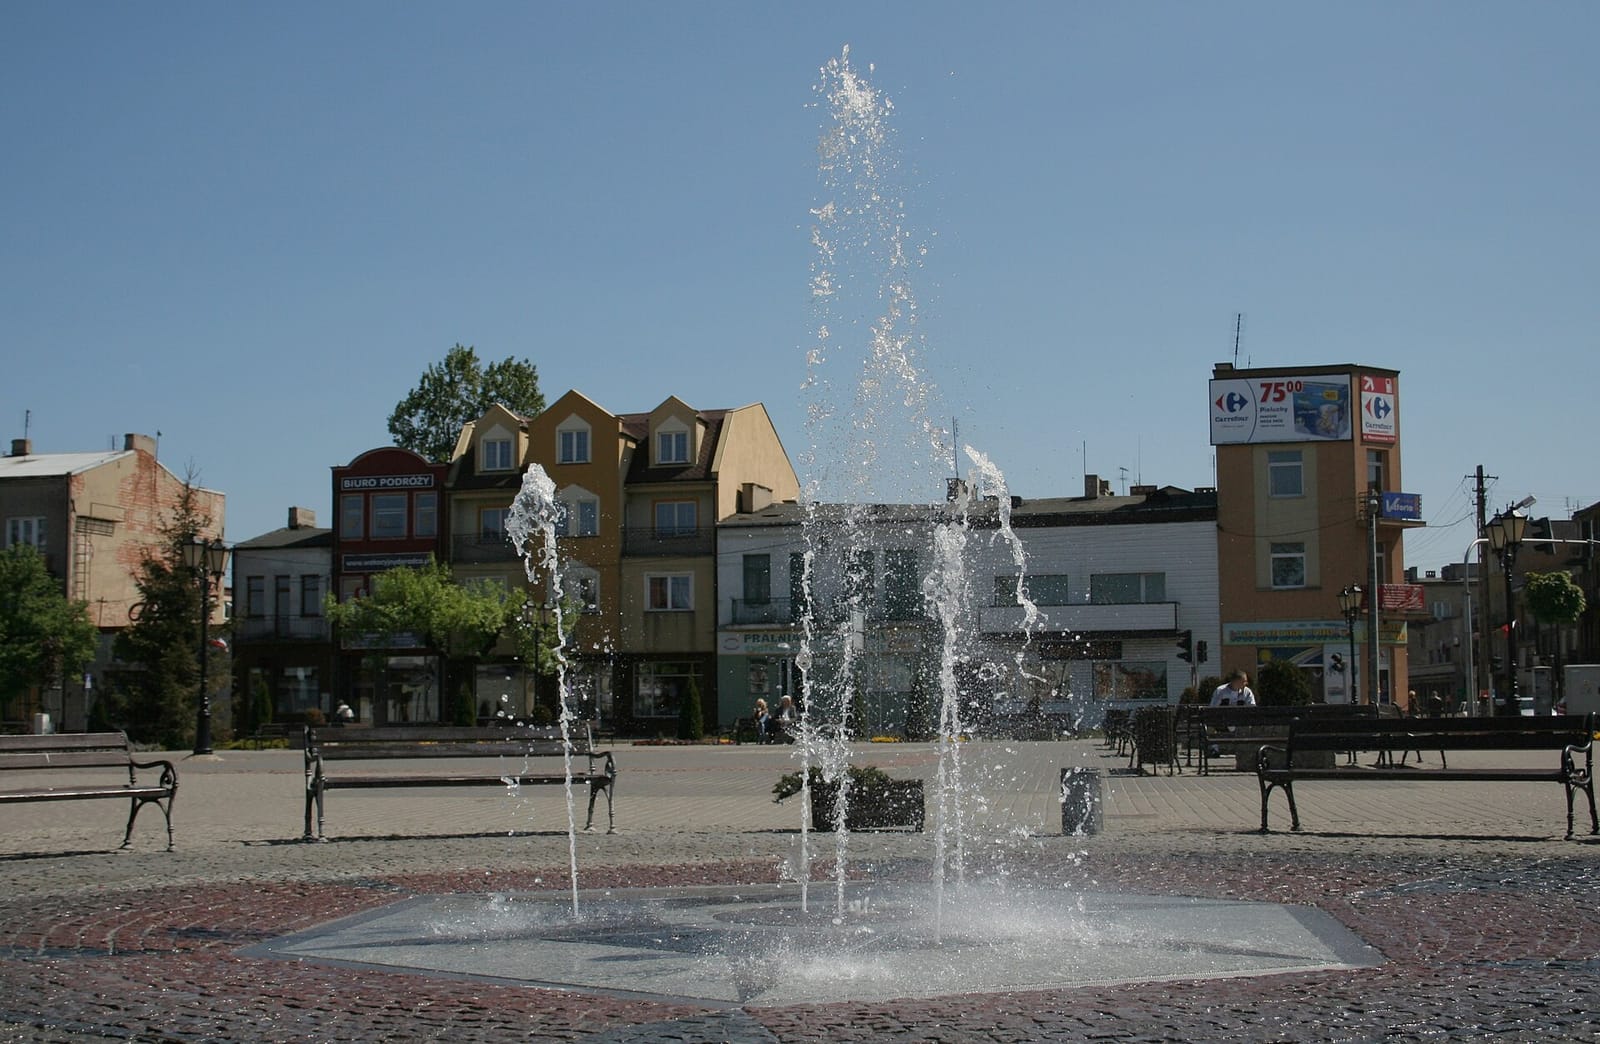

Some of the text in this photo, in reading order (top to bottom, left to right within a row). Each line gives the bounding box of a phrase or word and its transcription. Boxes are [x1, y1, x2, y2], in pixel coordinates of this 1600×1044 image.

[344, 476, 430, 488] BIURO PODRÓŻY
[743, 633, 801, 643] PRALNIA
